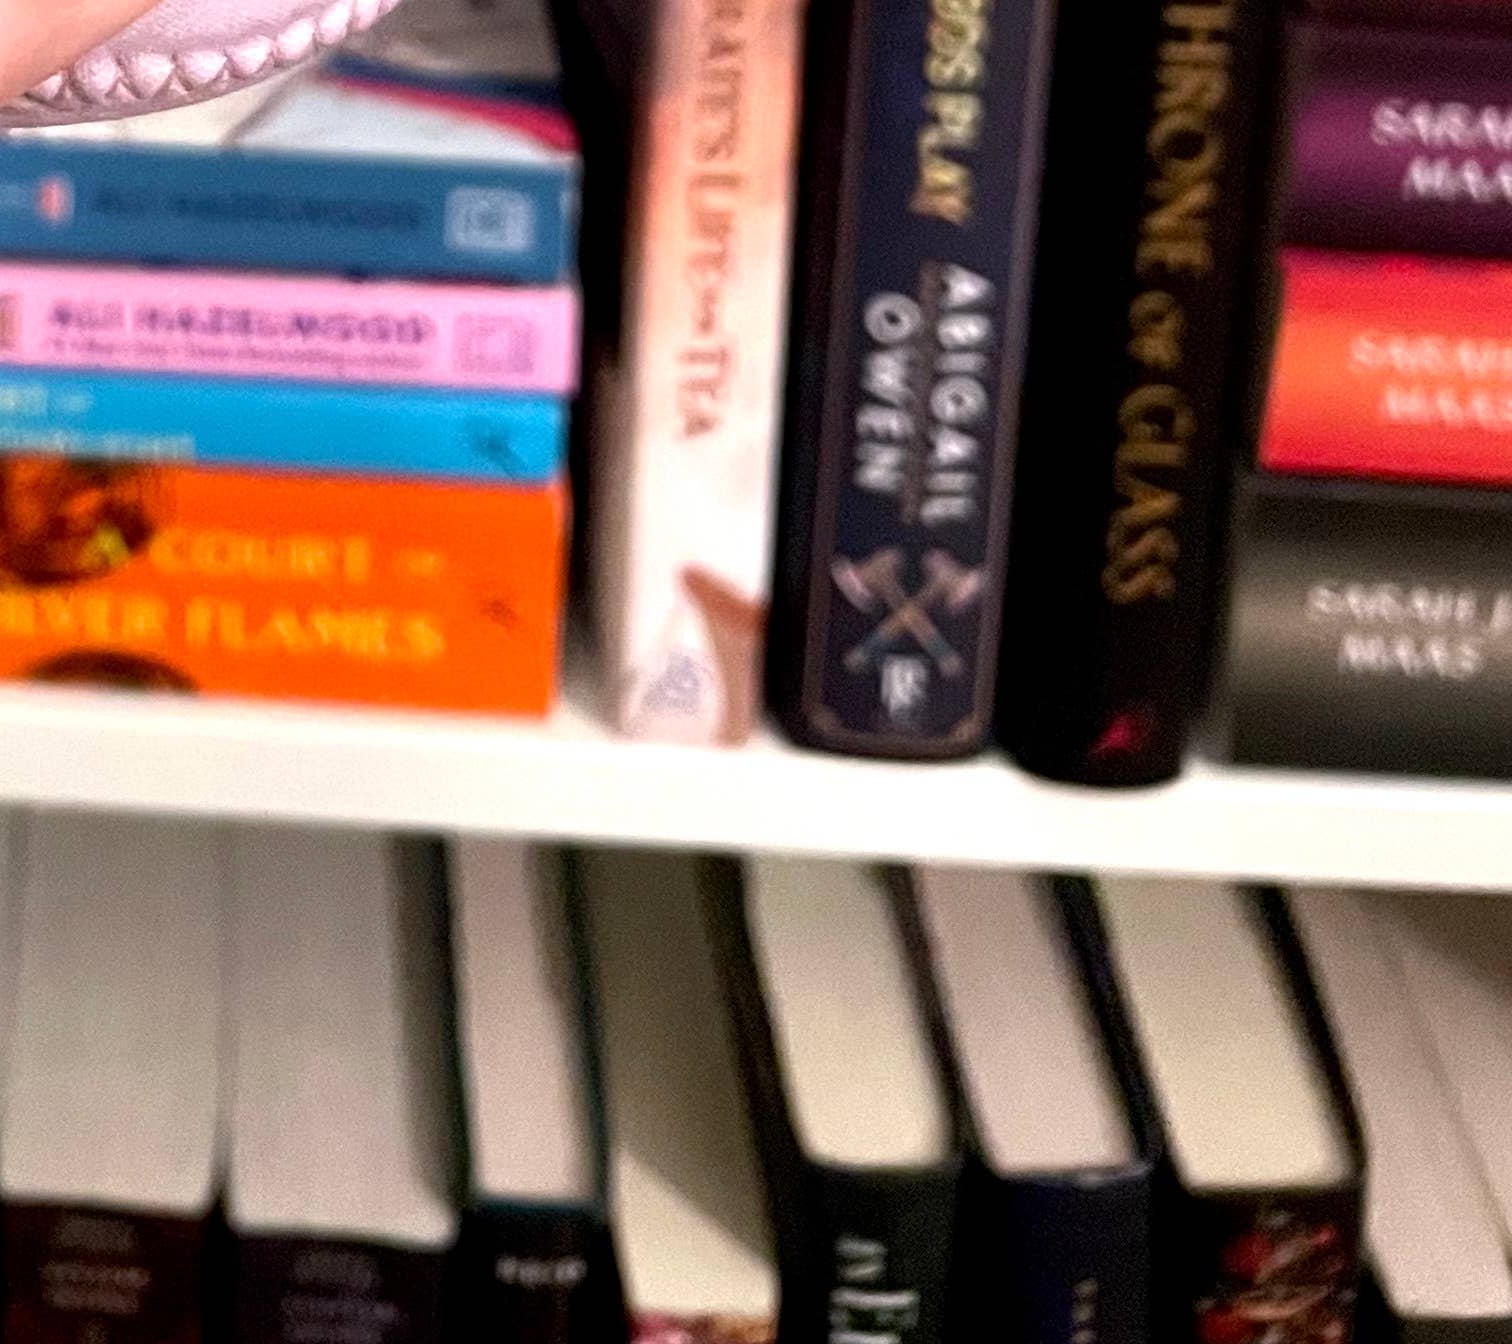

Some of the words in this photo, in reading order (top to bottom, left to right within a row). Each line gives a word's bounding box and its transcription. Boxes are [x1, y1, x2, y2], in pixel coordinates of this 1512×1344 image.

[906, 92, 984, 226] PLAY
[676, 347, 734, 441] TEA
[852, 289, 924, 496] OWEN
[917, 259, 996, 527] ABIGAIL
[148, 528, 372, 587] COURT
[1100, 381, 1196, 606] GLASS
[184, 595, 448, 662] FLAMES
